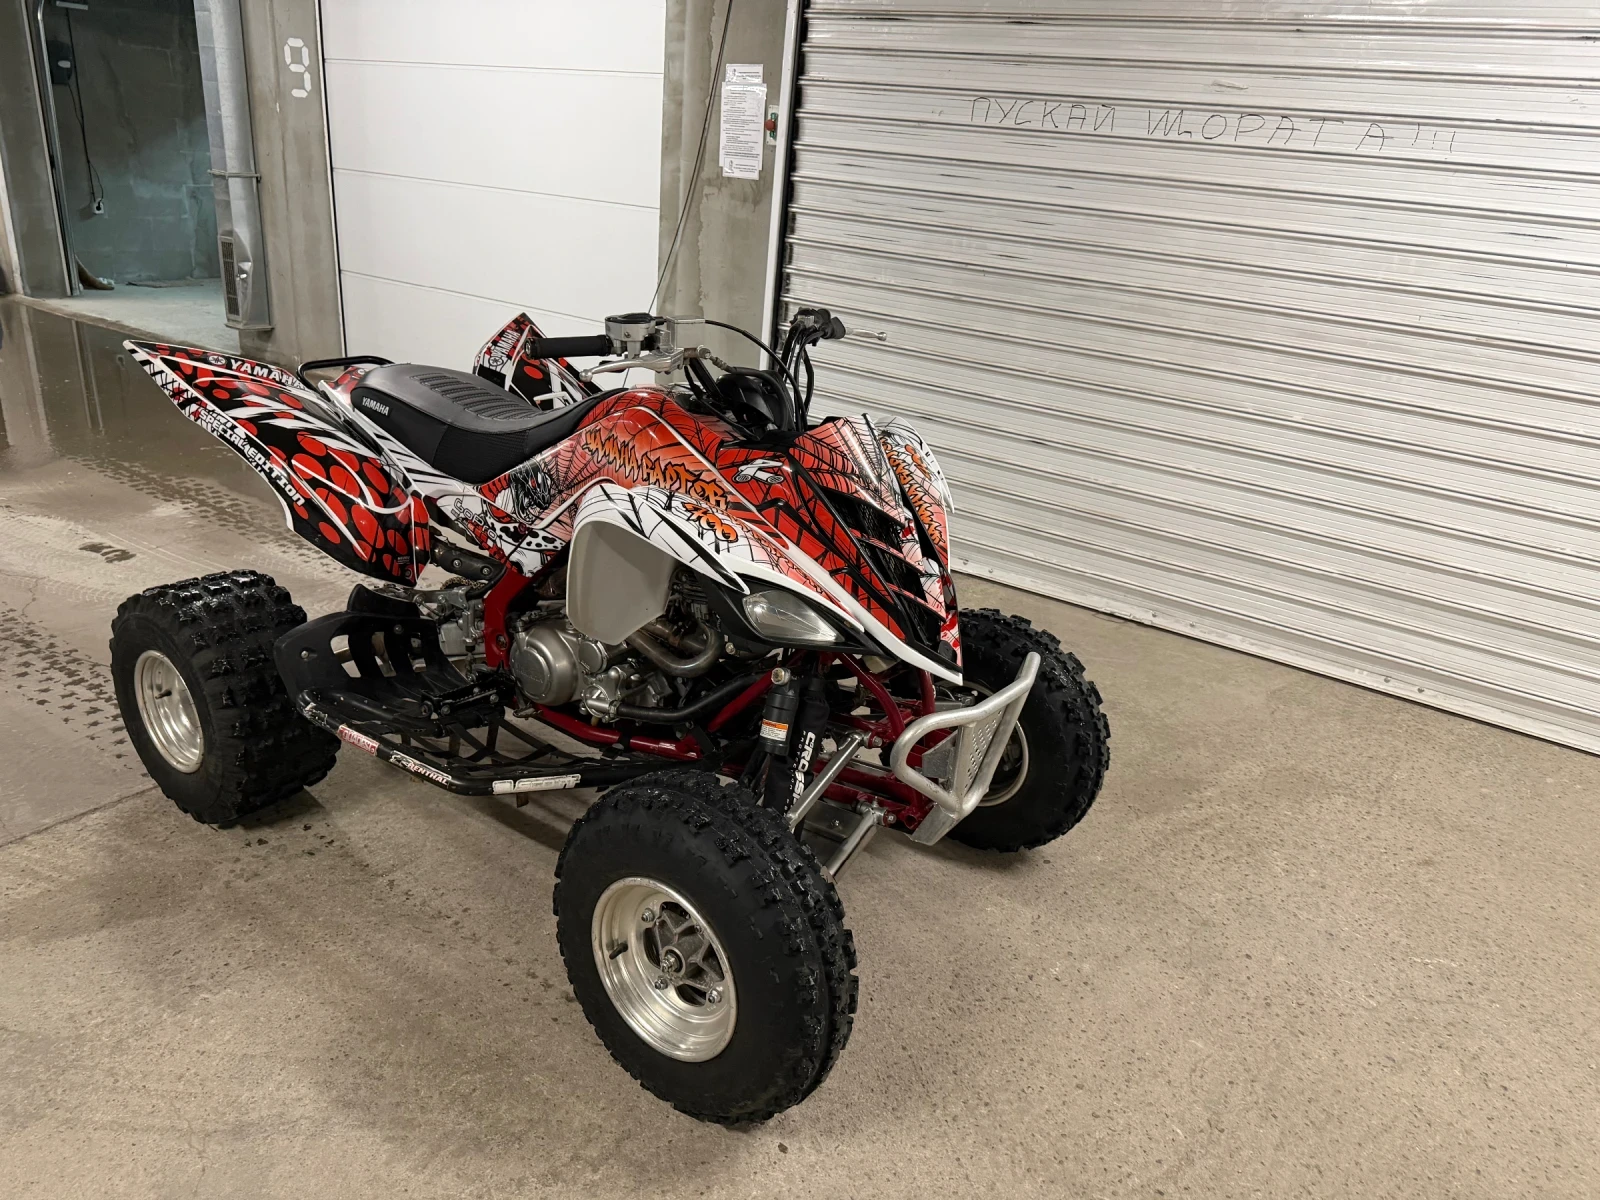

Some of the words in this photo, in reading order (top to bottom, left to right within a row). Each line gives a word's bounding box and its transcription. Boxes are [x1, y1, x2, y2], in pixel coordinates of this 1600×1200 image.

[284, 37, 312, 98] 9
[971, 96, 1116, 132] ПУСКАЙ
[496, 329, 520, 359] YAMAHA
[229, 358, 308, 390] YAMAHA
[361, 396, 390, 416] YAMAHA
[199, 408, 248, 453] SPECIAL
[247, 447, 306, 507] EDITION
[583, 427, 640, 482] YAMAHA
[639, 452, 728, 511] RAPTOR
[682, 501, 739, 543] 700
[406, 760, 449, 787] RENTHAL
